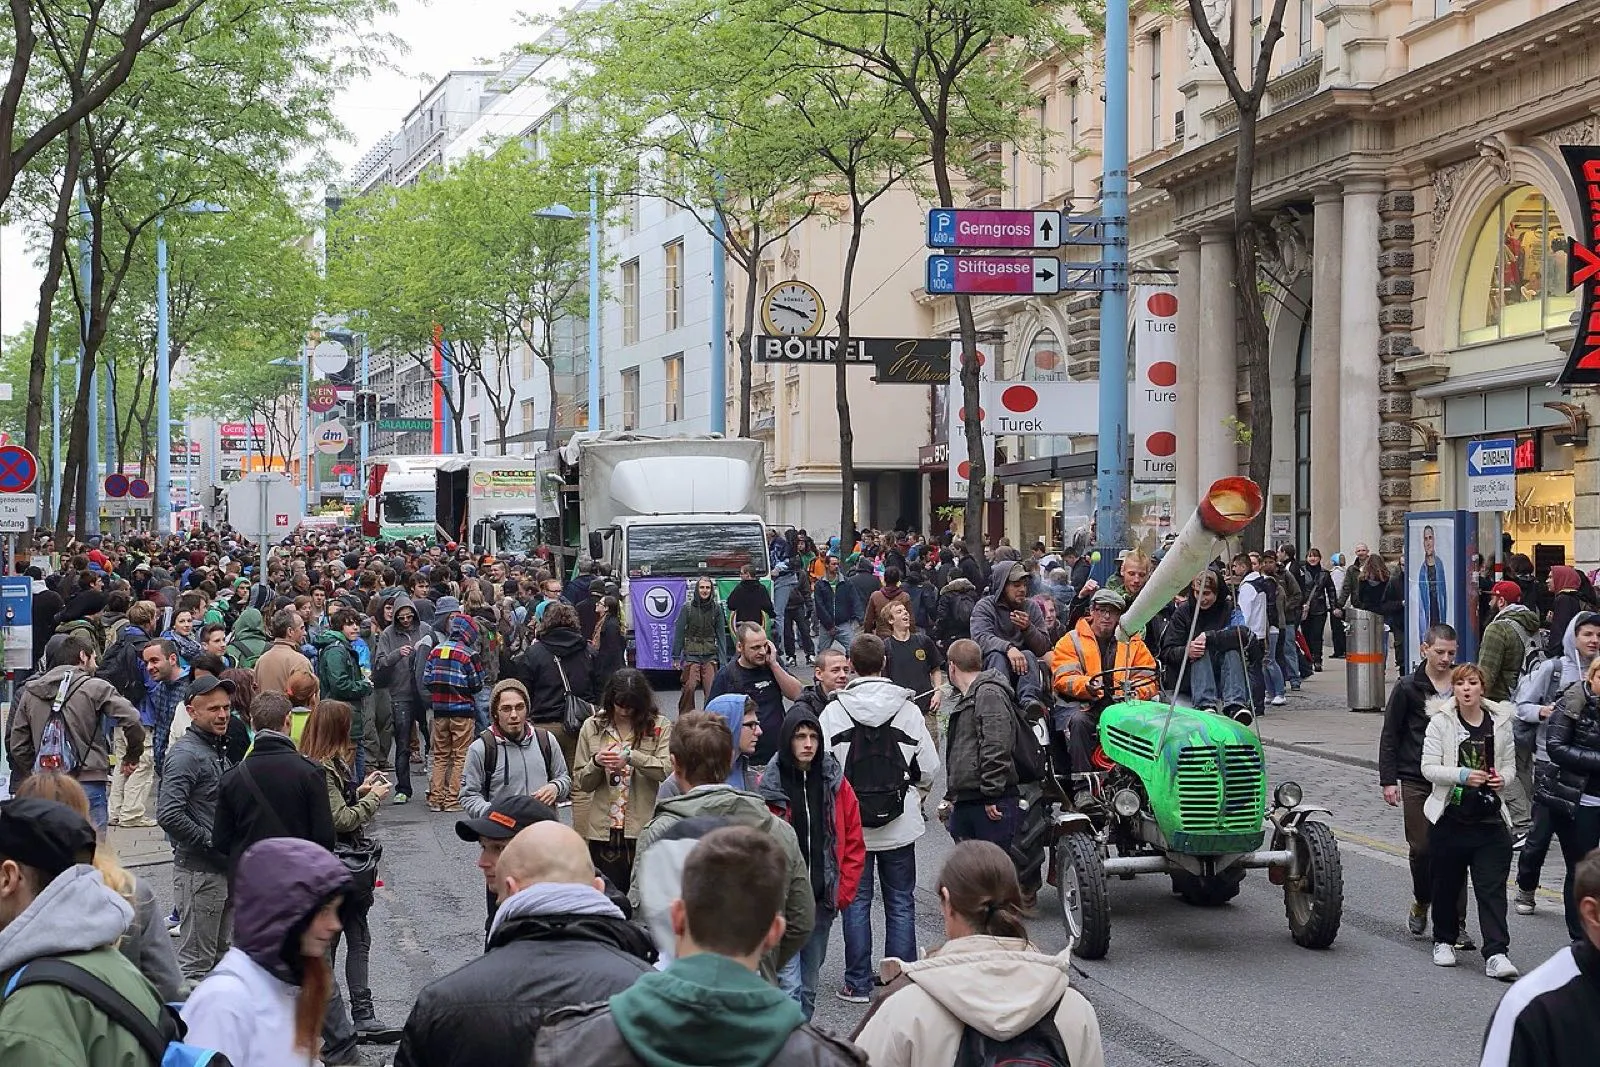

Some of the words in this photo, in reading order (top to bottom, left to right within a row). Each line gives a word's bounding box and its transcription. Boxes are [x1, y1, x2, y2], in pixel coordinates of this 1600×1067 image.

[960, 221, 1031, 237] Gerngross
[933, 232, 948, 243] 400
[958, 260, 1030, 275] Stiftgasse
[933, 278, 947, 289] 100
[1145, 320, 1177, 333] Ture
[766, 336, 873, 361] BÖHNEL
[319, 397, 333, 405] CO
[1145, 390, 1177, 402] Ture
[999, 417, 1043, 431] Turek
[322, 429, 342, 440] dm
[1482, 449, 1510, 466] EINBAHN
[1142, 459, 1177, 472] Ture
[659, 623, 670, 663] piraten
